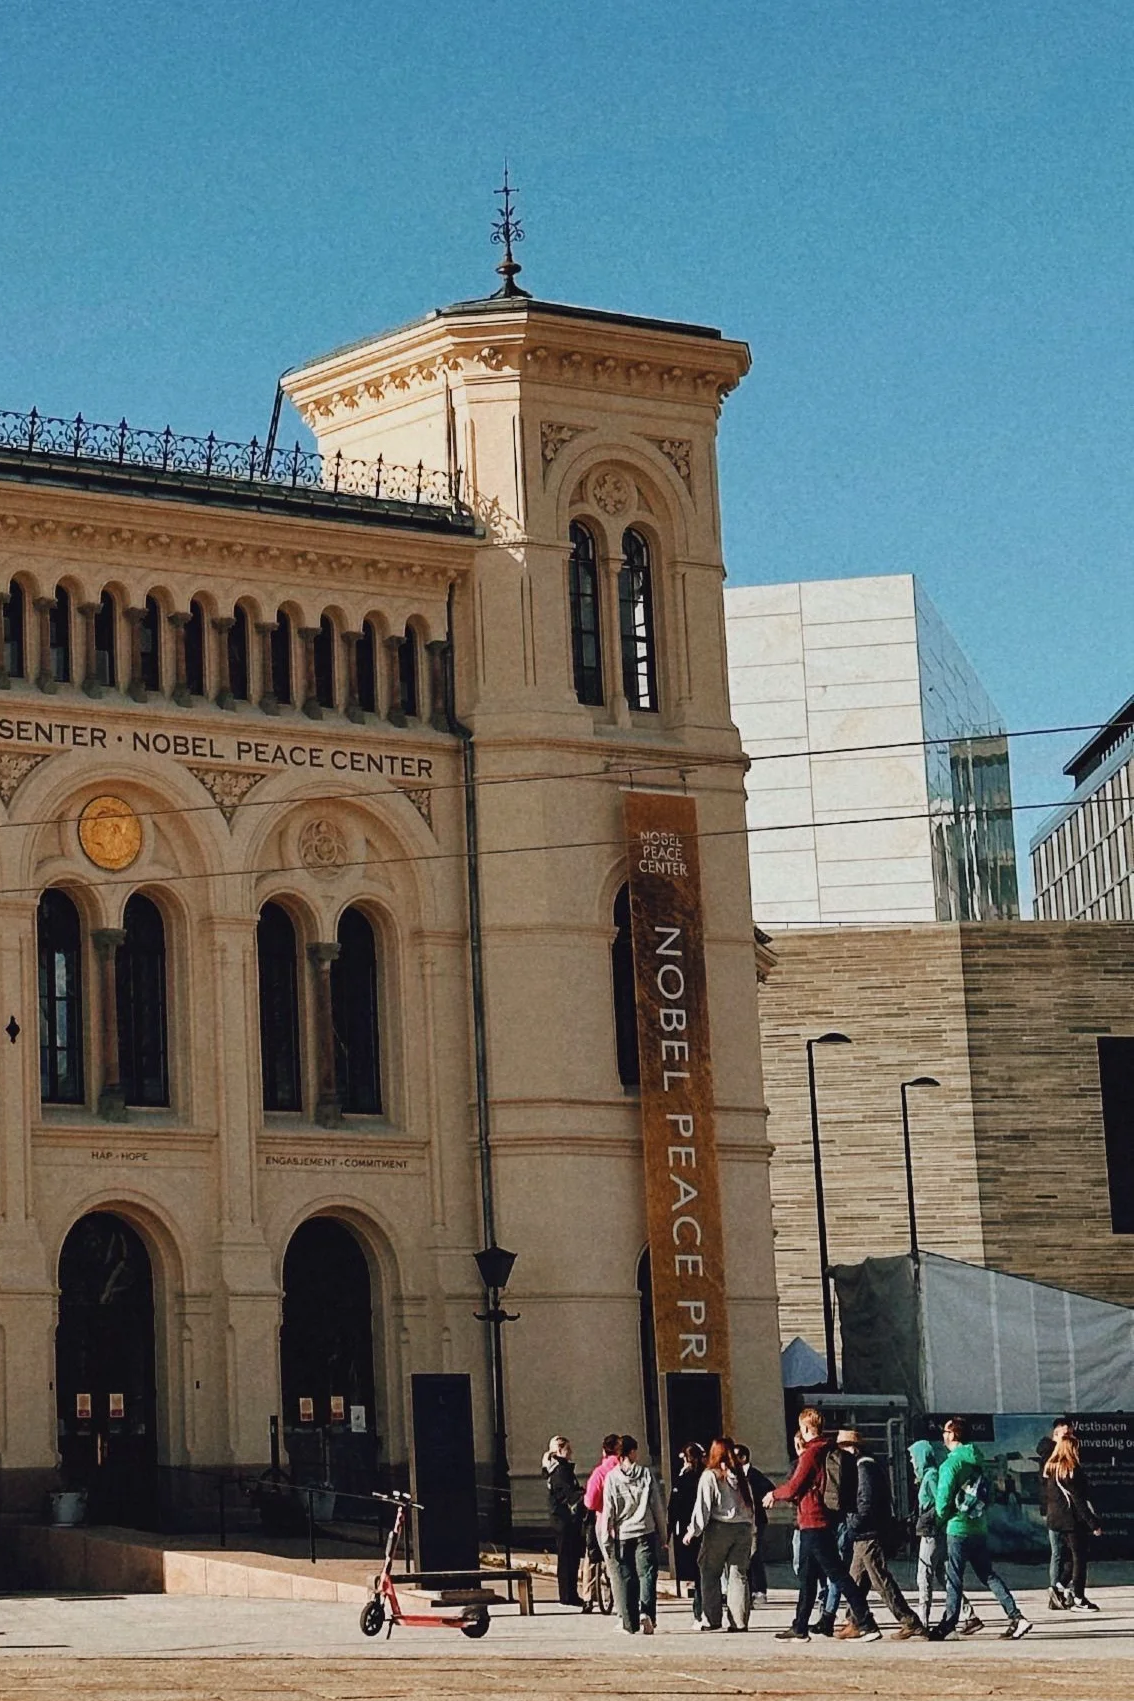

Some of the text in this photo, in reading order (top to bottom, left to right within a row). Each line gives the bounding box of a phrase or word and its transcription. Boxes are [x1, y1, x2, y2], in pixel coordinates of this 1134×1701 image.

[132, 731, 433, 779] NOBEL PEACE CENTER
[639, 831, 683, 847] NOBEL
[642, 846, 683, 862] PEACE
[638, 860, 688, 877] CENTER
[654, 926, 691, 1092] NOBEL
[121, 1152, 150, 1161] HOPE
[265, 1156, 409, 1169] ENGASJEMENT COMMITMENT
[666, 1113, 704, 1278] PEACE
